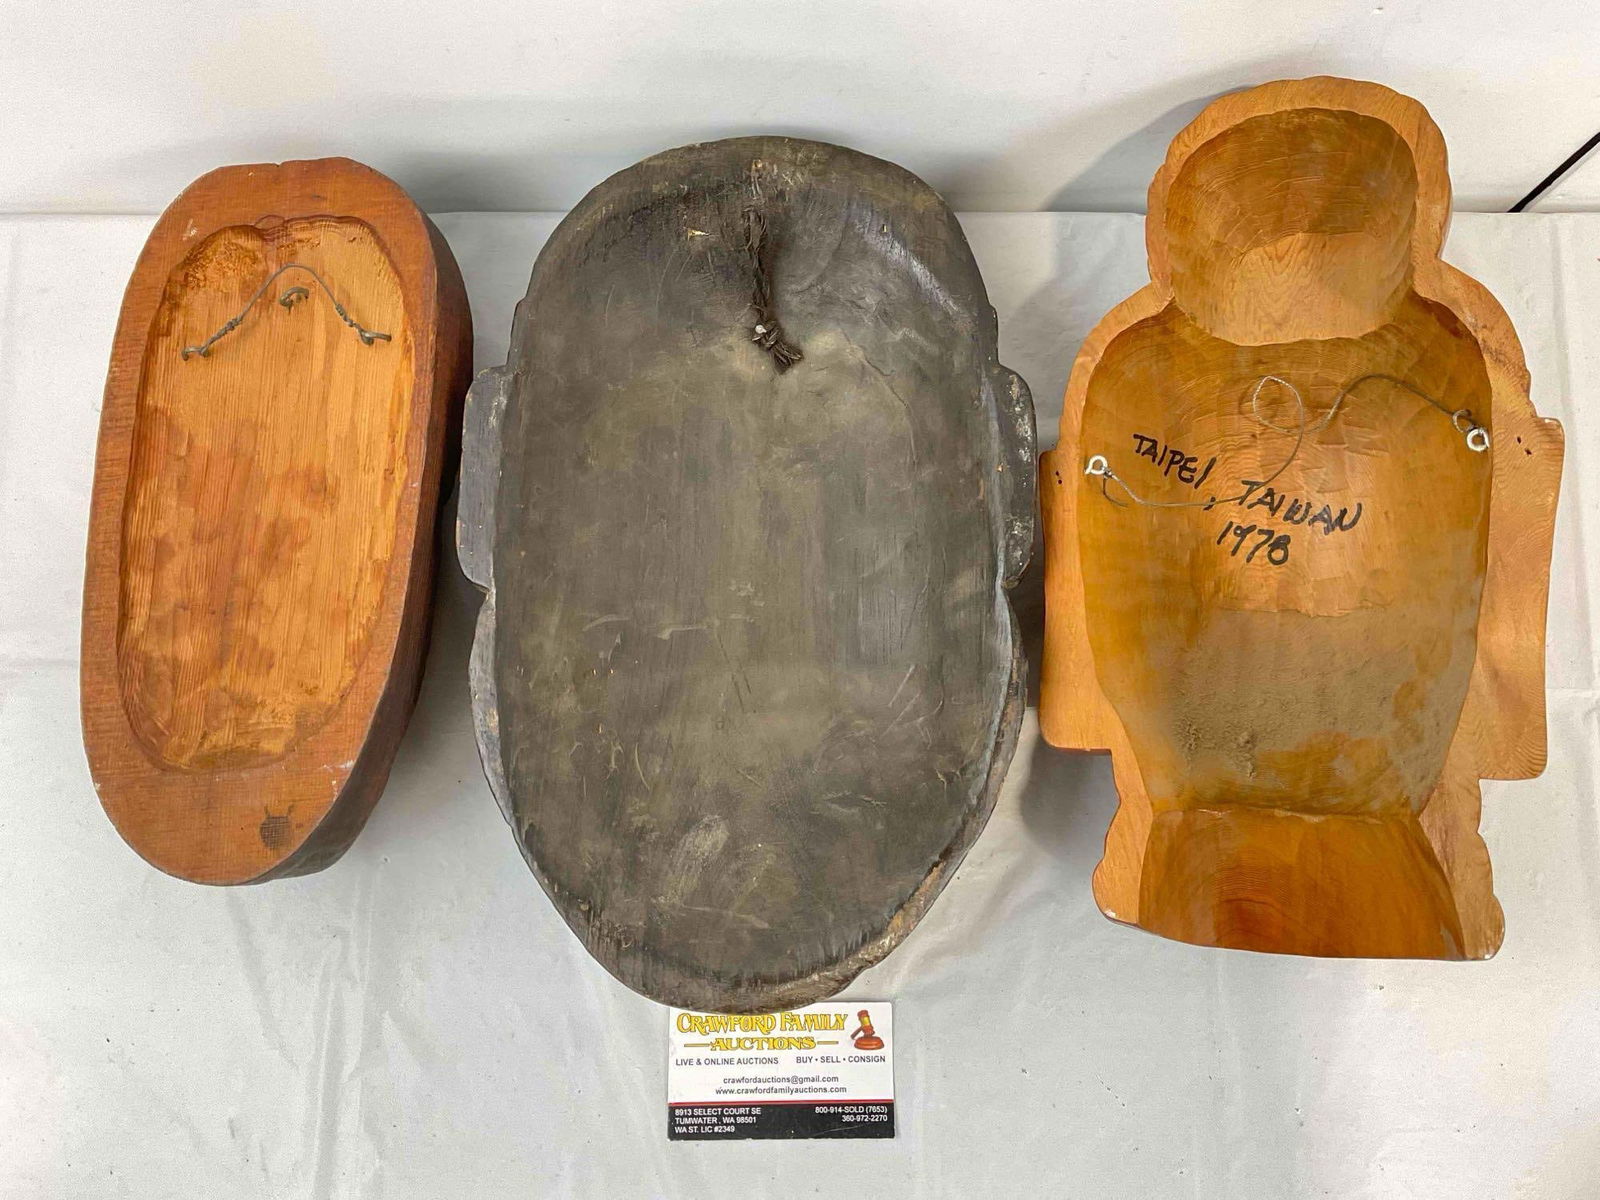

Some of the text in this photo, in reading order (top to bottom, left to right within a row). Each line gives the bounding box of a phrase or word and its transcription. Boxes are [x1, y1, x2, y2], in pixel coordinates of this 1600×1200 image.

[1238, 480, 1362, 535] TAIWAN
[1217, 521, 1291, 565] 1978
[676, 1013, 848, 1035] CRAWFORD FAMILY
[710, 1037, 816, 1051] AUCTIONS
[737, 1057, 779, 1065] AUCTIONS
[723, 1076, 839, 1085] crawfordauctions@gmail.com
[716, 1086, 847, 1095] www.crawfordfamilyauctions.com
[815, 1106, 887, 1114] 800-914-SOLD (7653)
